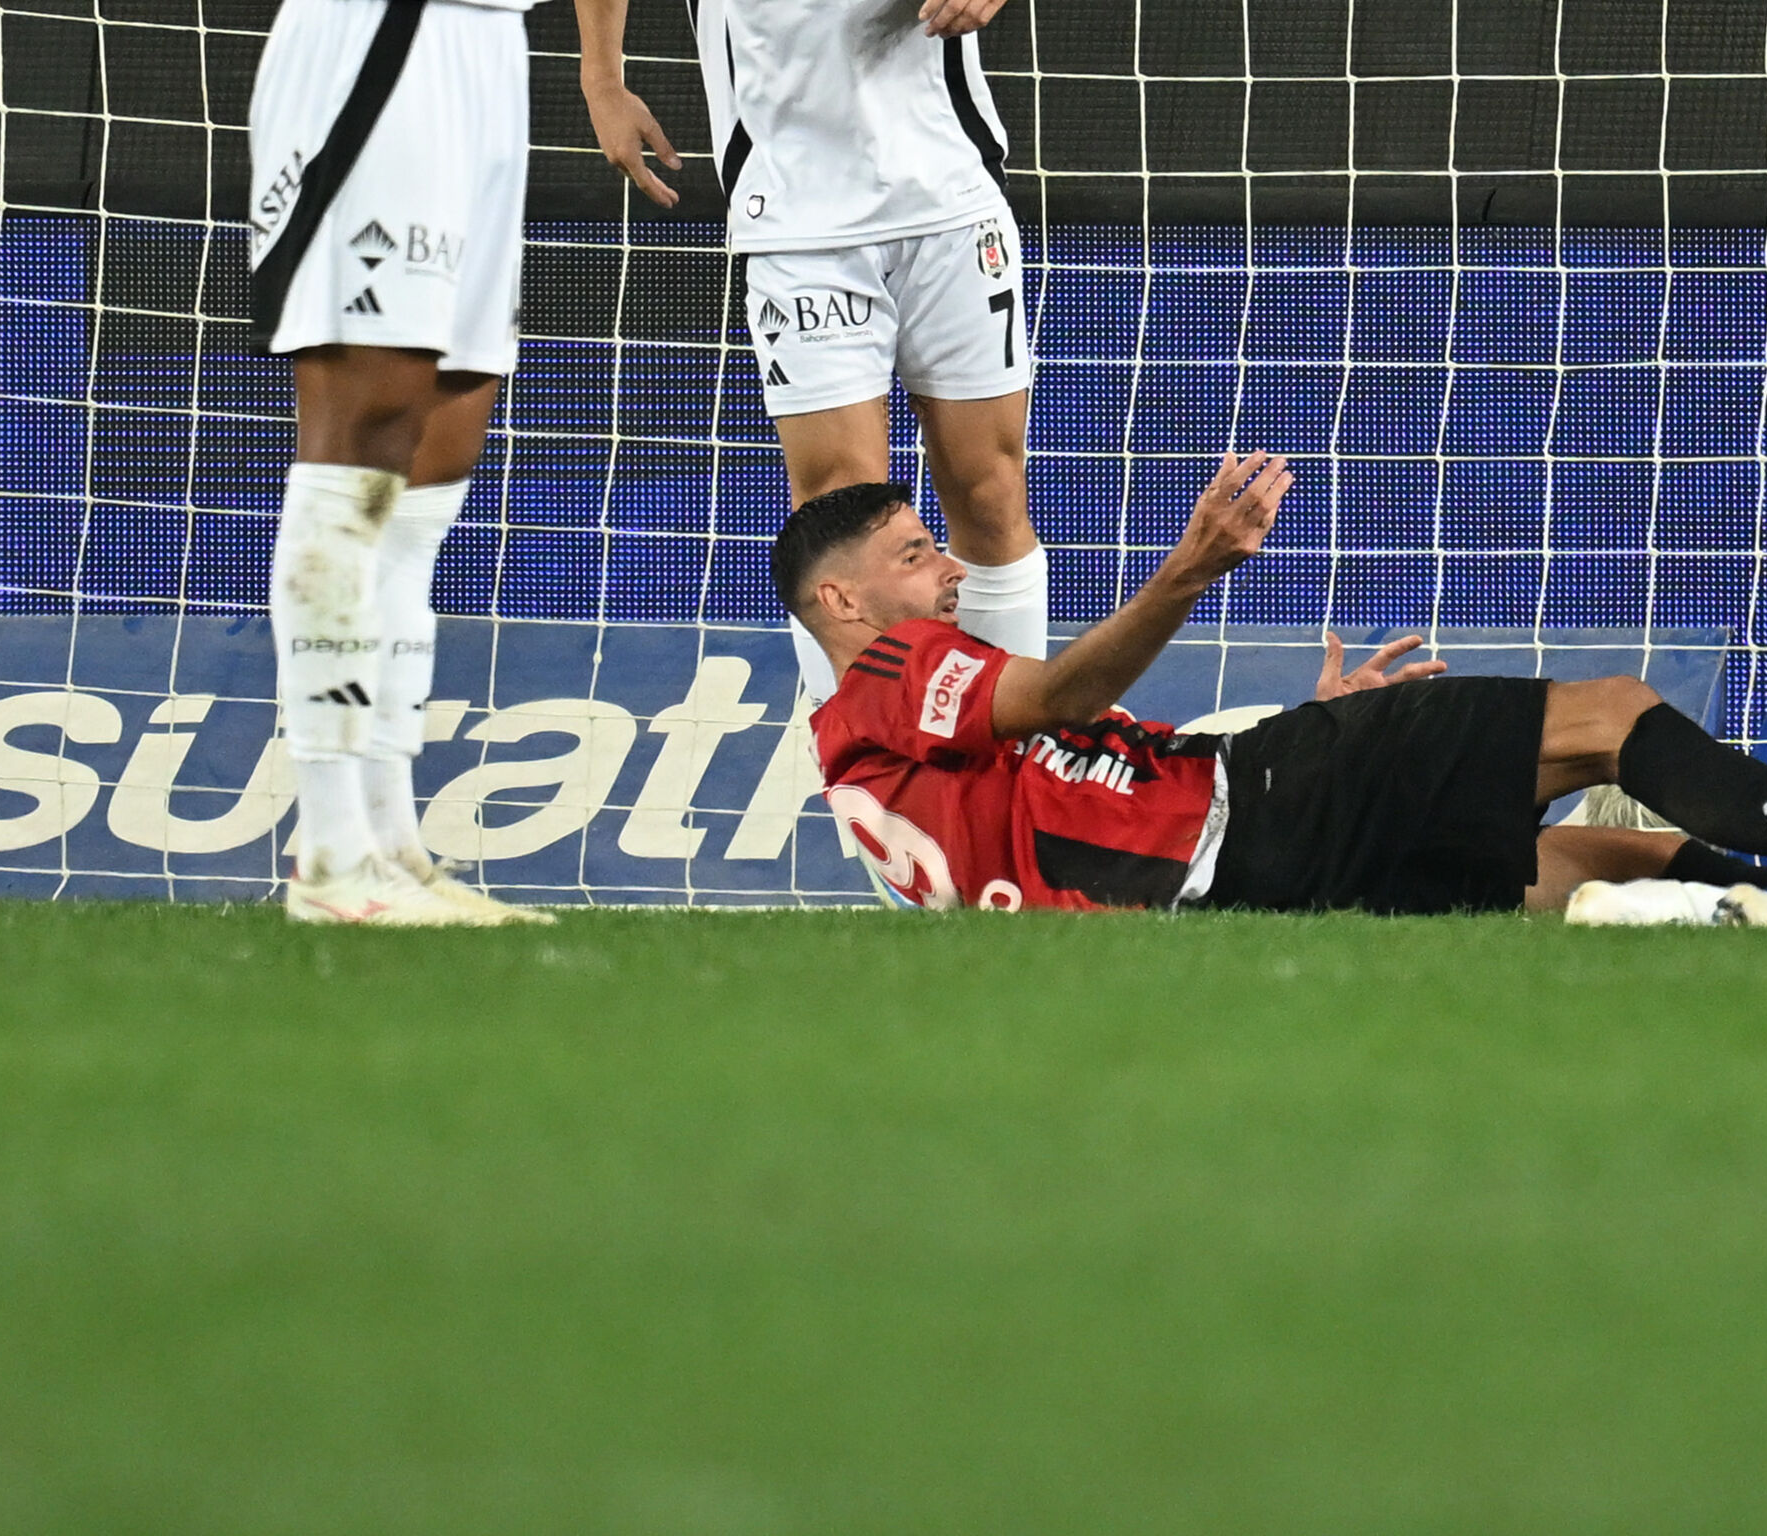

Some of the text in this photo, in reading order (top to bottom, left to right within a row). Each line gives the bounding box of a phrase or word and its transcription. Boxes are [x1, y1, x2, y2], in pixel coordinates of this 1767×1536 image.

[792, 290, 875, 332] BAU
[988, 288, 1016, 369] 7
[930, 661, 971, 724] YORK
